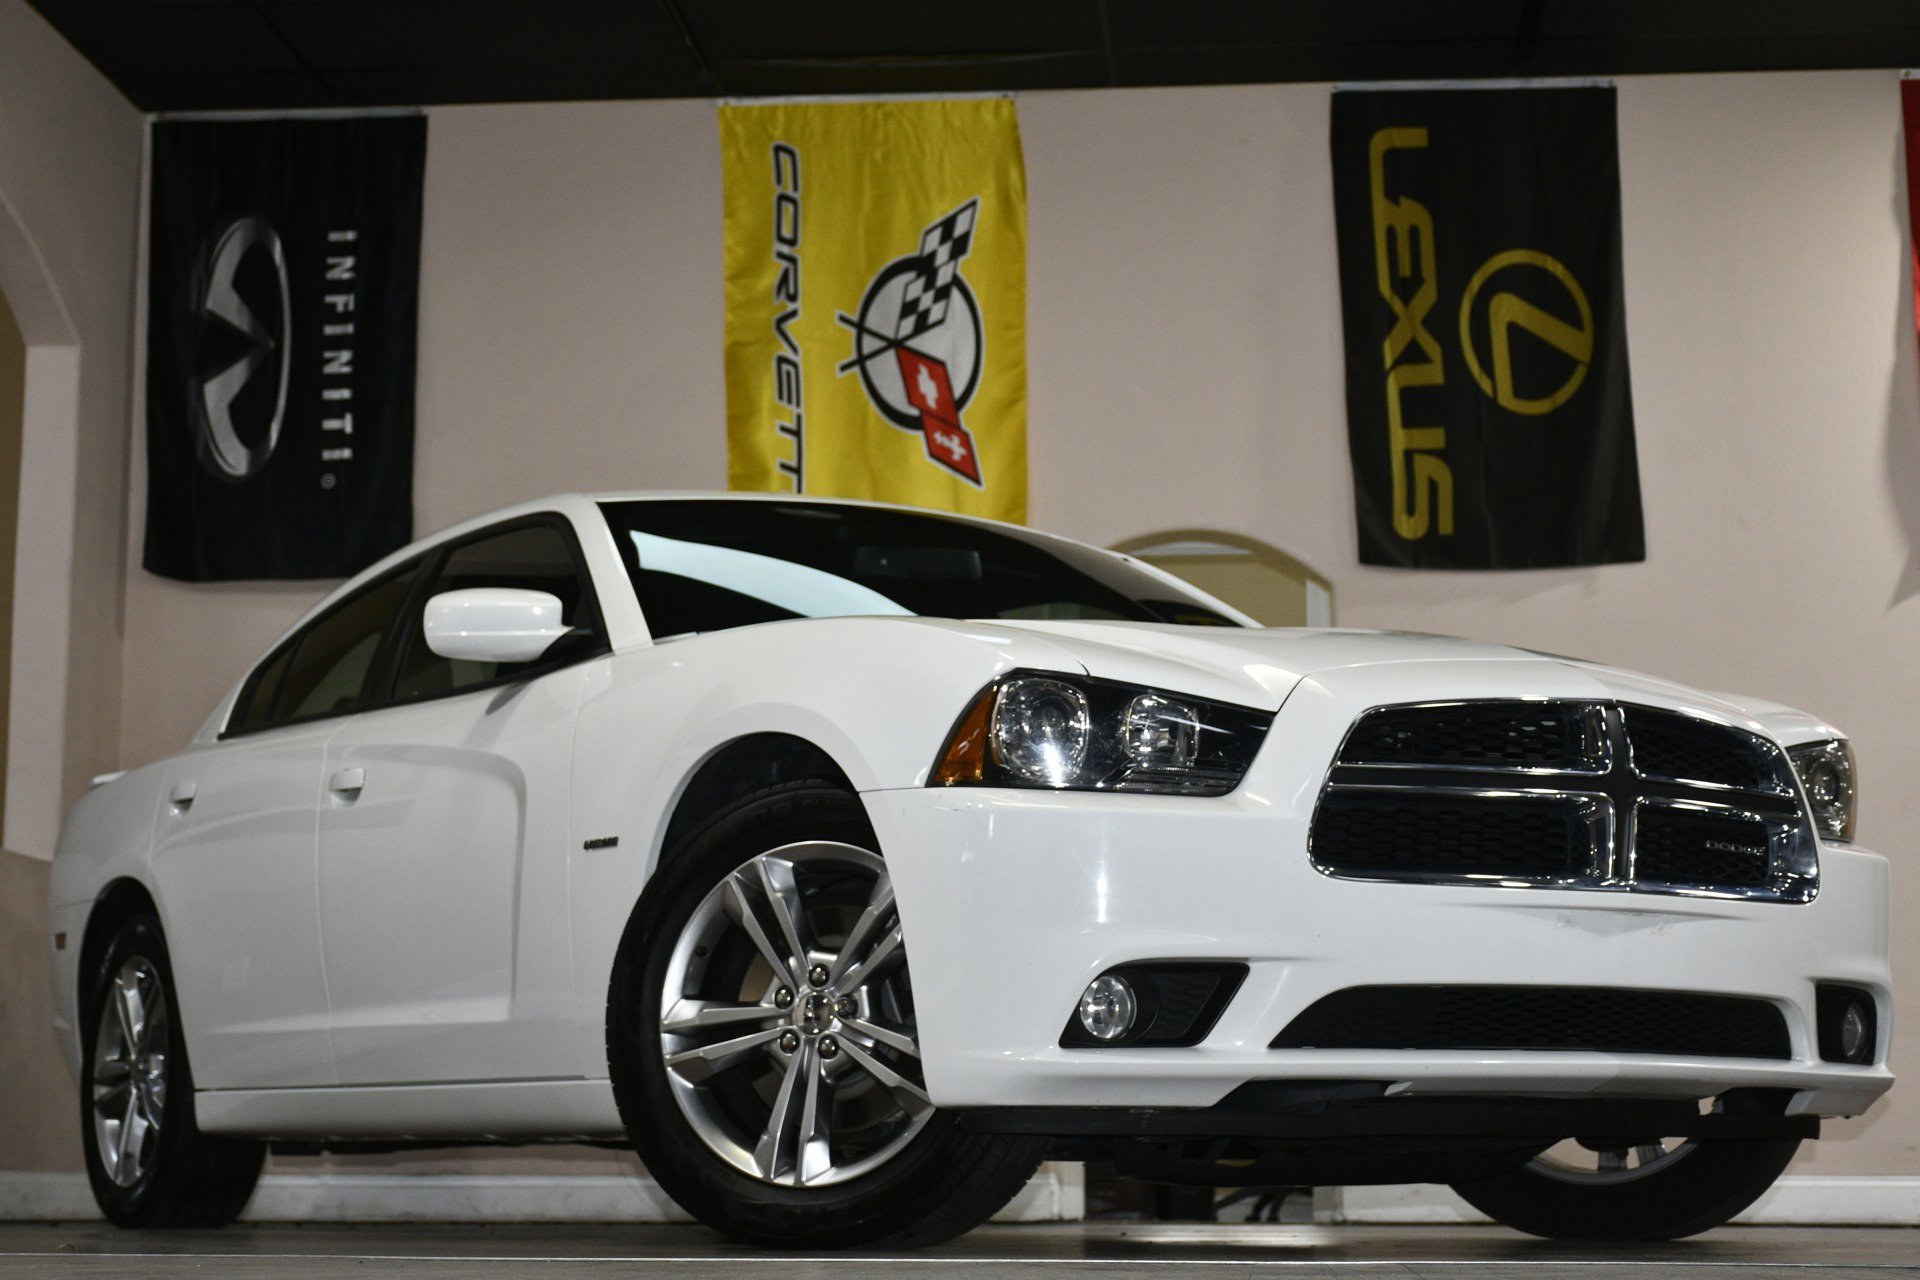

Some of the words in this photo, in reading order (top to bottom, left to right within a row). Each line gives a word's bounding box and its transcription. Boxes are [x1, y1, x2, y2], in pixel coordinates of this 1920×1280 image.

[320, 230, 359, 462] INFINITI
[771, 141, 804, 494] CORVETT
[1368, 126, 1455, 542] LEXUS
